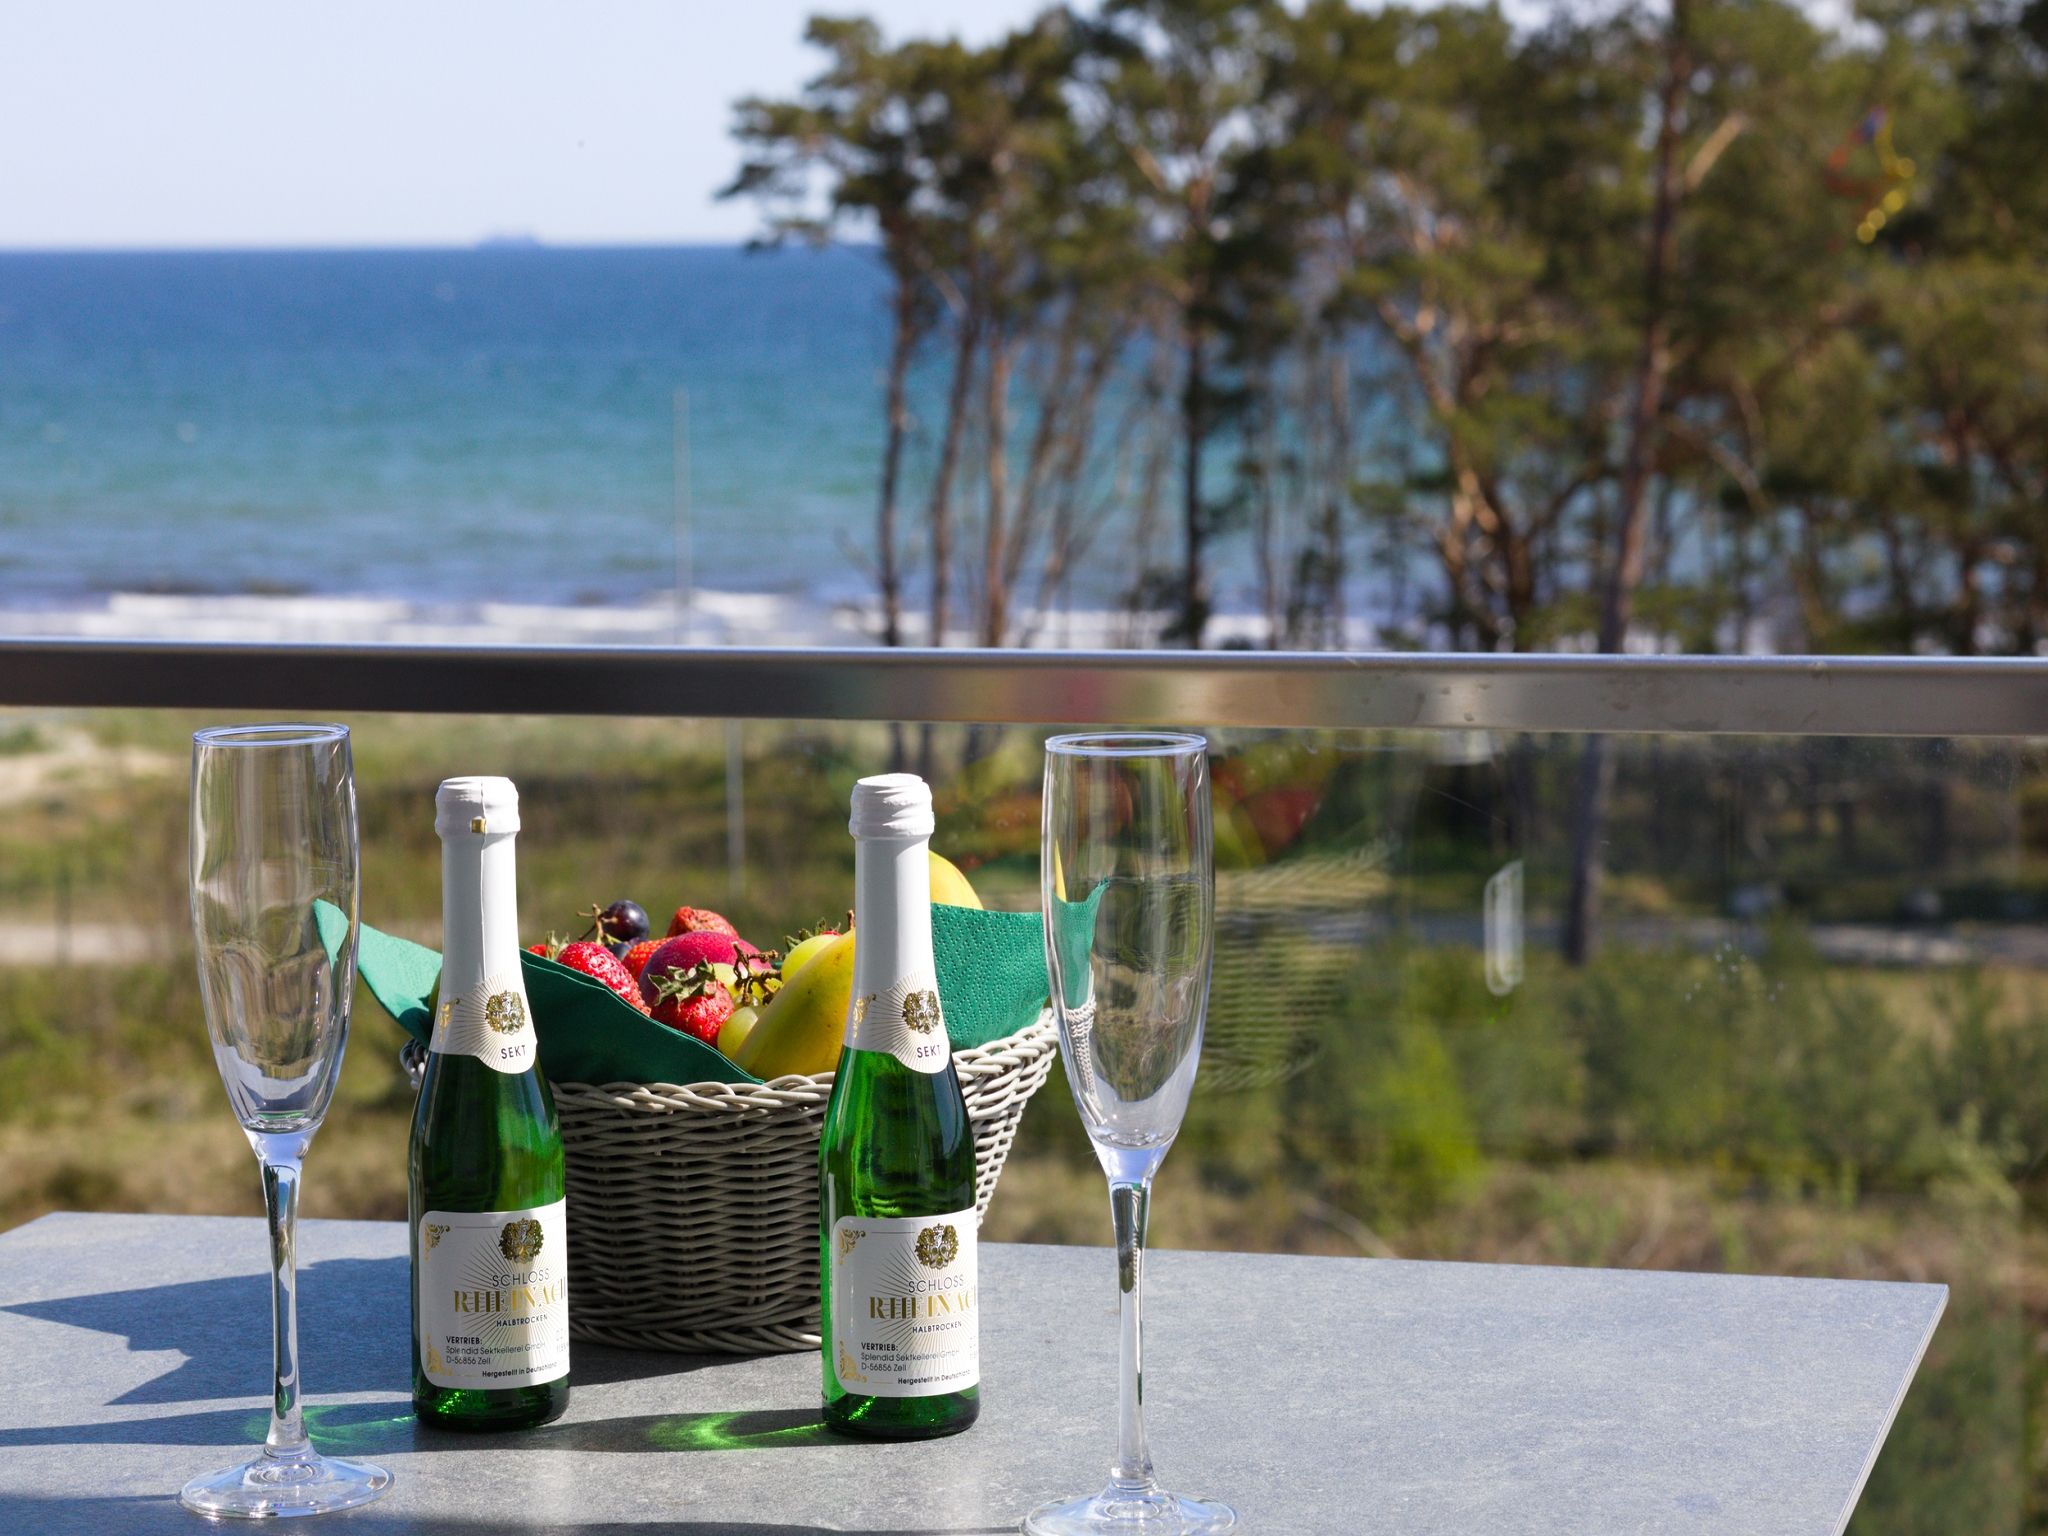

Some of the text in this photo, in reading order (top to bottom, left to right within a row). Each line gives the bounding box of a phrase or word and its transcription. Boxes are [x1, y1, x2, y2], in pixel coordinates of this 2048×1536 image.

[500, 1045, 526, 1060] SEKT
[916, 1045, 941, 1058] SEKT
[492, 1268, 550, 1287] SCHLOSS
[908, 1274, 964, 1293] SCHLOSS
[496, 1315, 548, 1328] HALBTROCKEN
[912, 1321, 962, 1333] HALBTROCKEN
[446, 1336, 483, 1345] VERTRIEB:
[446, 1346, 479, 1356] Splendid
[480, 1345, 524, 1355] Sektkellerei
[861, 1342, 898, 1351] VERTRIEB:
[446, 1356, 491, 1365] D-56856 Zell
[861, 1352, 894, 1362] Splendid
[895, 1352, 938, 1362] Sektkellerei
[861, 1362, 907, 1372] D-56856 Zell
[482, 1369, 518, 1379] Hergestellt
[897, 1374, 933, 1385] Hergestellt
